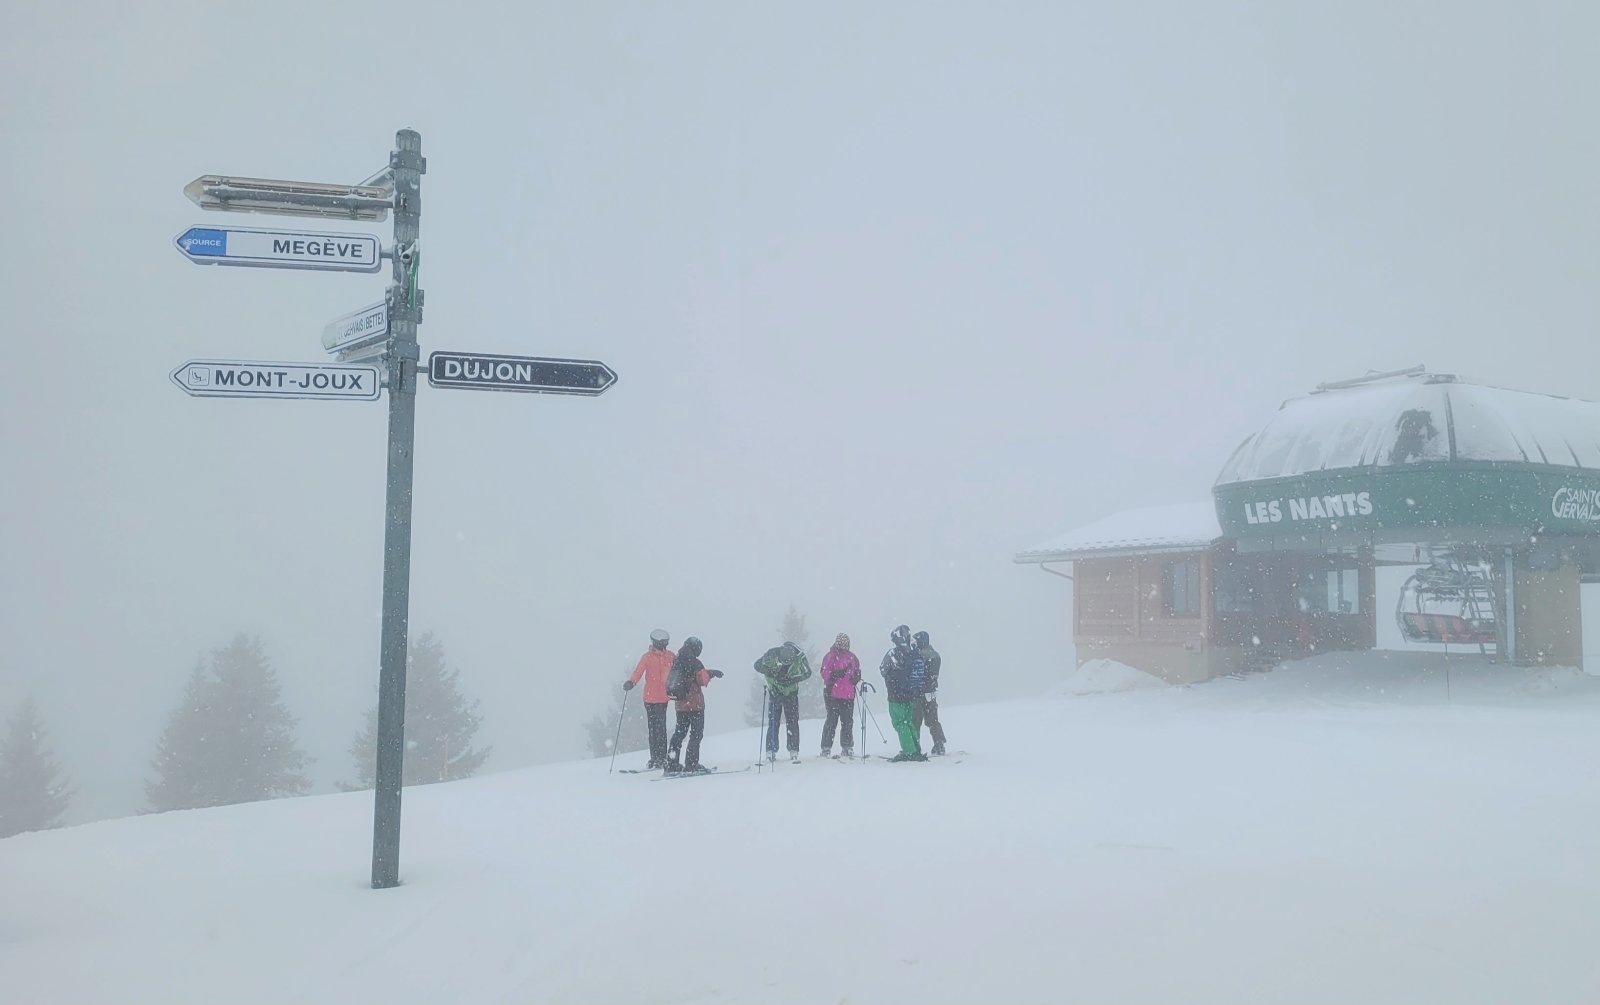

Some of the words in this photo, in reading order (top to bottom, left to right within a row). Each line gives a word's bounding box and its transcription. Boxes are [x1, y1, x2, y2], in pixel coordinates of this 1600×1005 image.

[186, 238, 221, 247] SOURCE
[273, 239, 363, 258] MEGÈVE
[215, 369, 363, 390] MONT-JOUX
[444, 360, 532, 382] DUJON
[1566, 487, 1597, 504] SAINT
[1244, 500, 1283, 524] LES
[1289, 491, 1373, 520] NANTS
